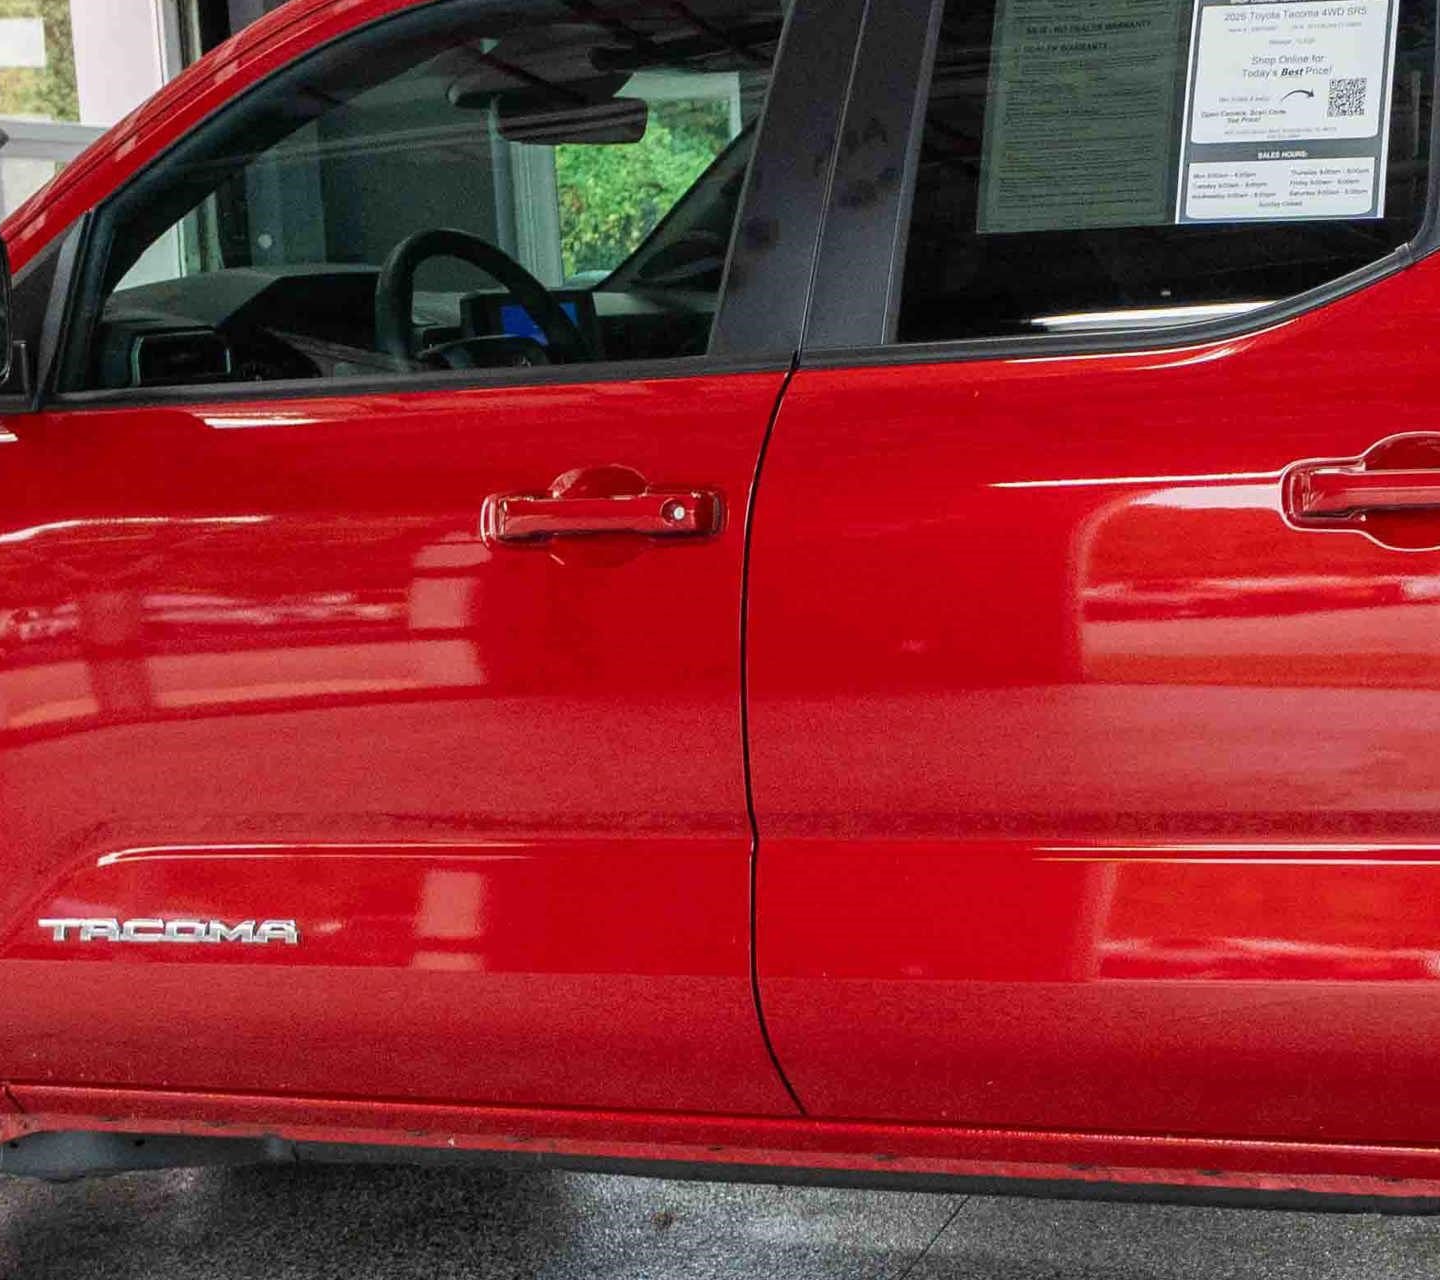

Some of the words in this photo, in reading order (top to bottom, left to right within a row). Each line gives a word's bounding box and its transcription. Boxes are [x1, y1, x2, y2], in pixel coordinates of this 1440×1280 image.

[1249, 10, 1281, 23] Toyota
[1282, 8, 1320, 20] Tacoma
[1321, 7, 1345, 18] 4WD
[1251, 55, 1276, 66] Shop
[1278, 54, 1309, 65] Online
[1311, 54, 1324, 63] for
[1242, 68, 1278, 79] Today's
[1280, 67, 1304, 77] Best
[1305, 65, 1333, 76] Price!
[38, 918, 299, 944] TACOMA
